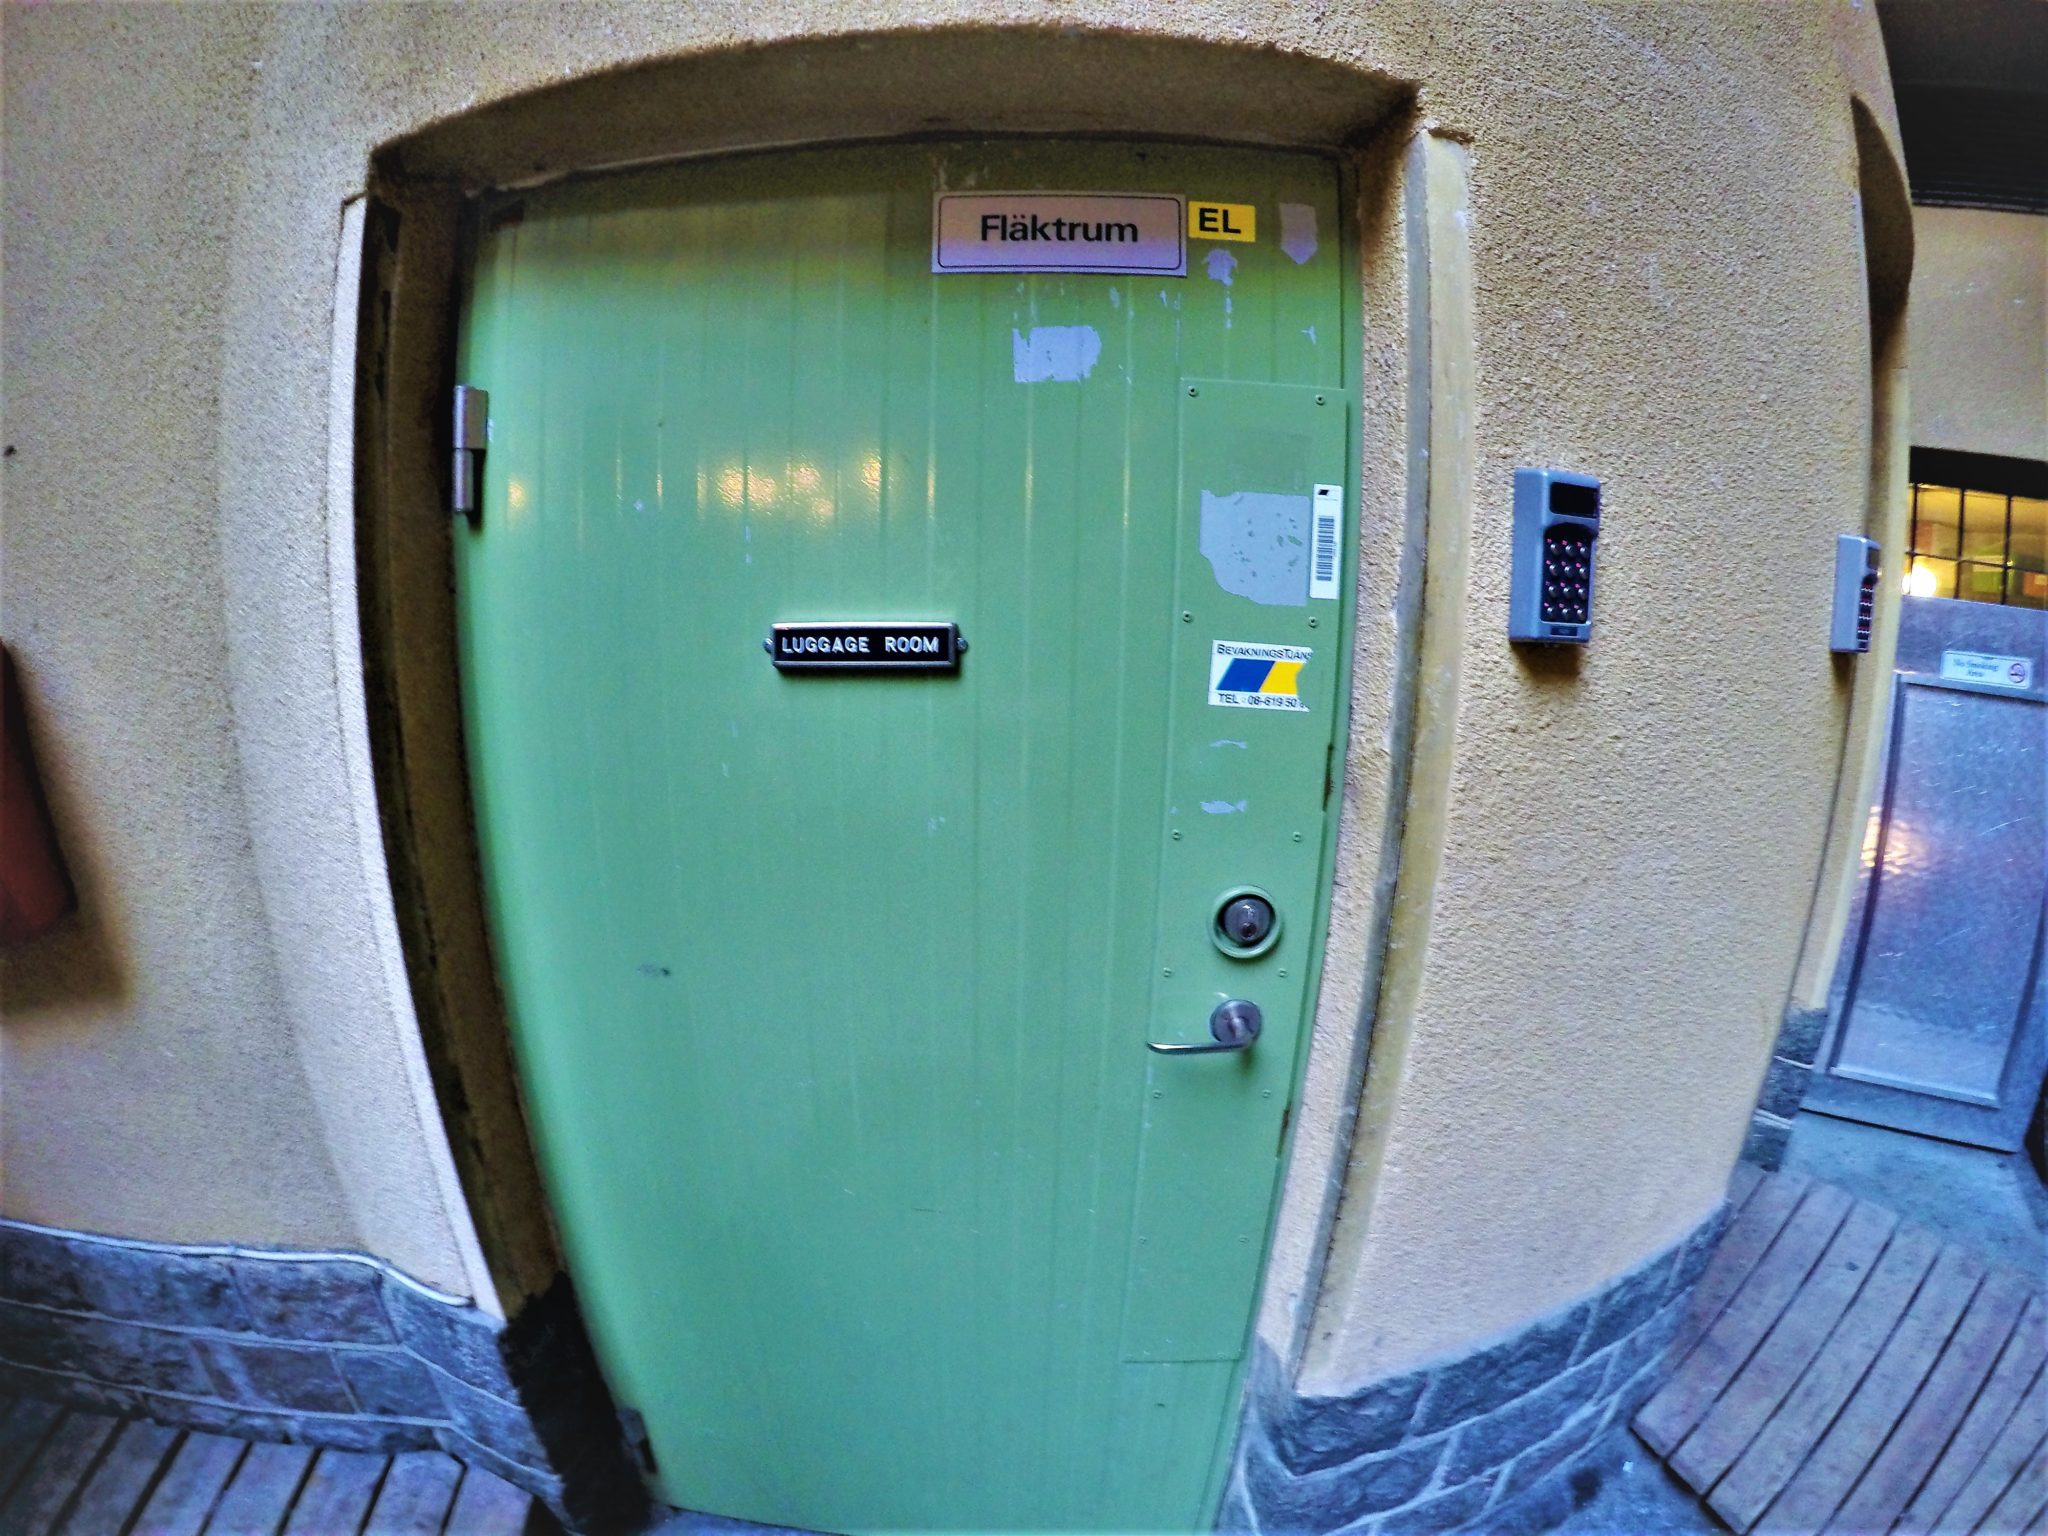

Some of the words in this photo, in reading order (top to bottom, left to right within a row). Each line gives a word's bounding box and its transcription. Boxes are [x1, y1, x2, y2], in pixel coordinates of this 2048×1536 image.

[980, 213, 1139, 243] Fläktrum
[1199, 208, 1241, 234] EL
[781, 636, 870, 654] LUGGAGE
[884, 636, 940, 653] ROOM
